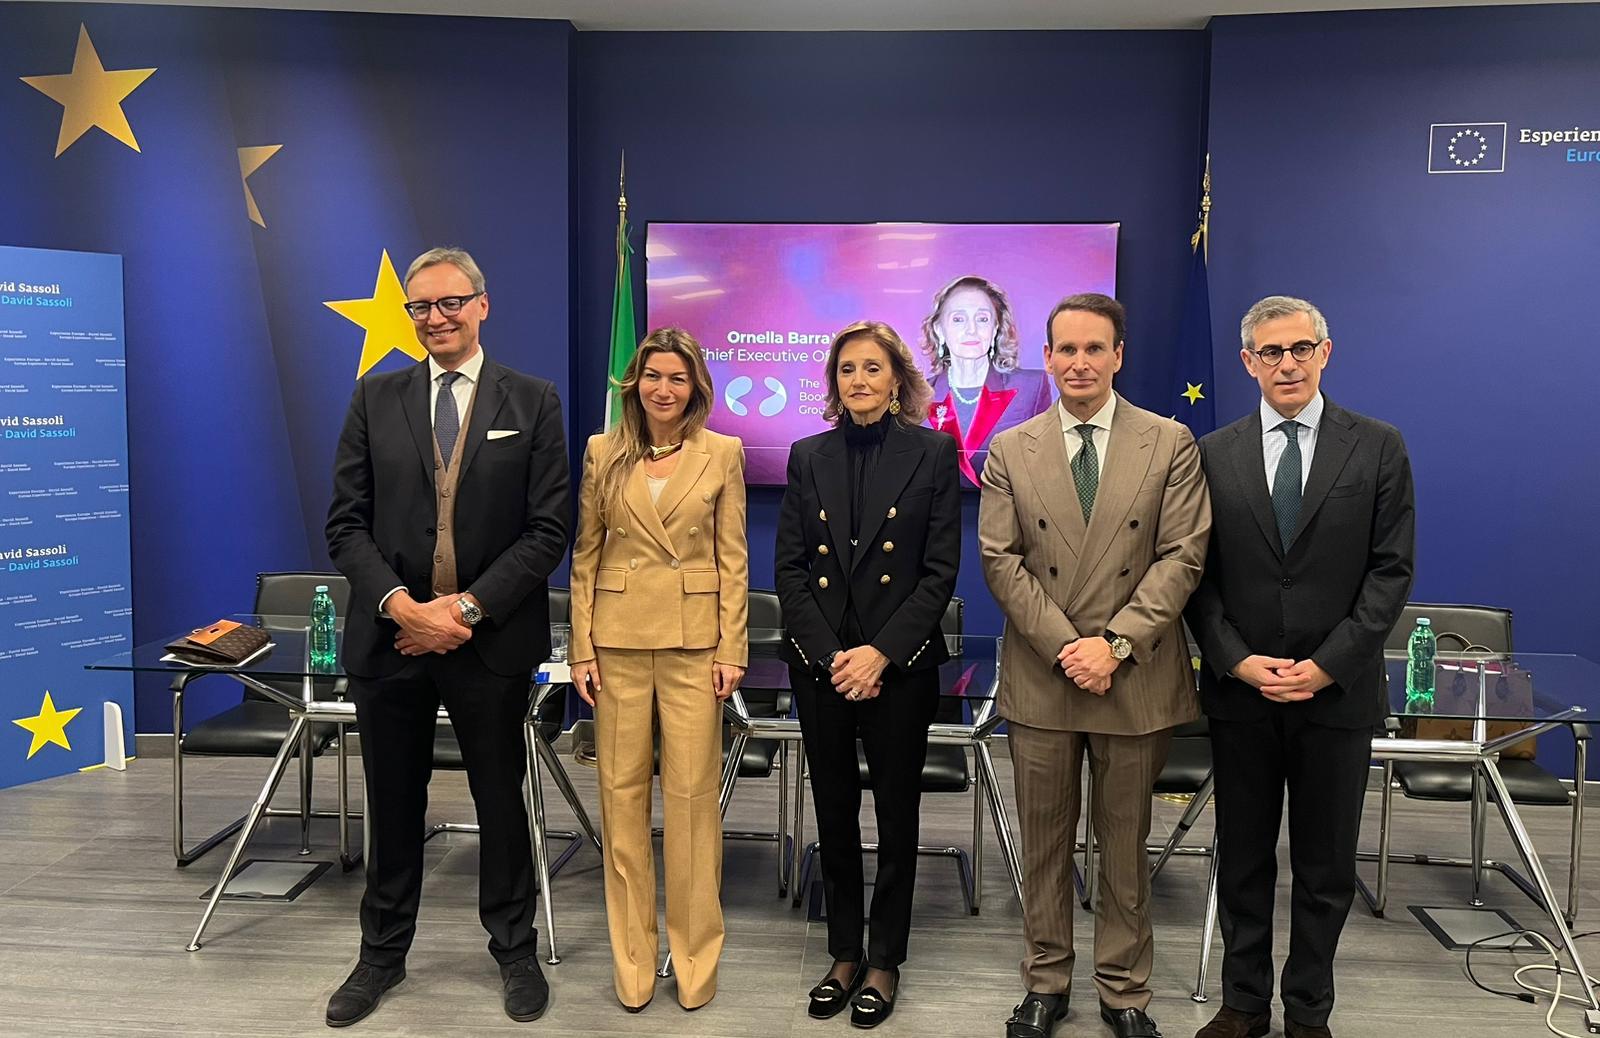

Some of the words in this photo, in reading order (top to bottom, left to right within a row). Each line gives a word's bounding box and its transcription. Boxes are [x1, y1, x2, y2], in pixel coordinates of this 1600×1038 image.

[1519, 126, 1600, 146] Esperien
[18, 283, 60, 294] Sassoli
[1, 295, 33, 306] David
[36, 297, 72, 307] Sassoli
[727, 331, 784, 344] Ornella
[788, 332, 830, 344] Barra
[737, 348, 808, 362] Executive
[799, 378, 820, 389] The
[22, 415, 64, 426] Sassoli
[5, 428, 37, 439] David
[40, 427, 76, 438] Sassoli
[25, 542, 67, 557] Sassoli
[8, 560, 40, 572] David
[42, 555, 79, 568] Sassoli
